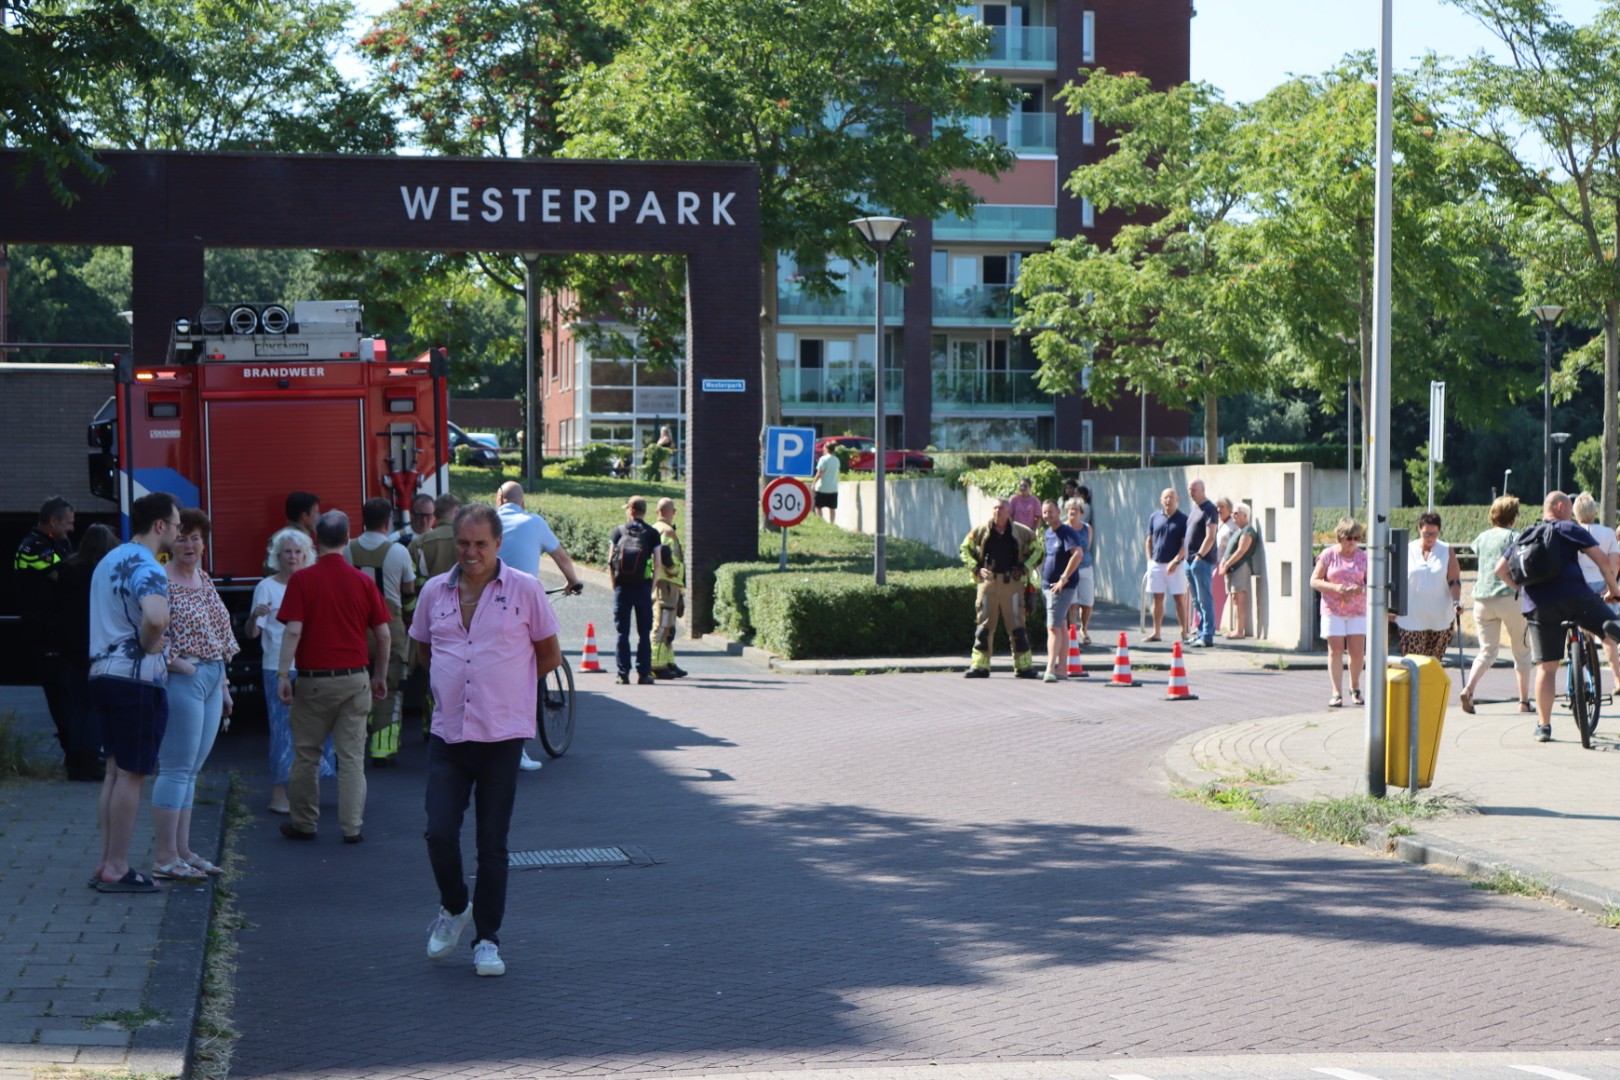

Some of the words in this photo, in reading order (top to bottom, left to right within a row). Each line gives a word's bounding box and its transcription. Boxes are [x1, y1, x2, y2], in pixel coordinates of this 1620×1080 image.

[400, 186, 736, 226] WESTERPARK
[243, 366, 325, 378] BRANDWEER
[705, 382, 743, 390] Westerpark
[776, 433, 804, 471] P
